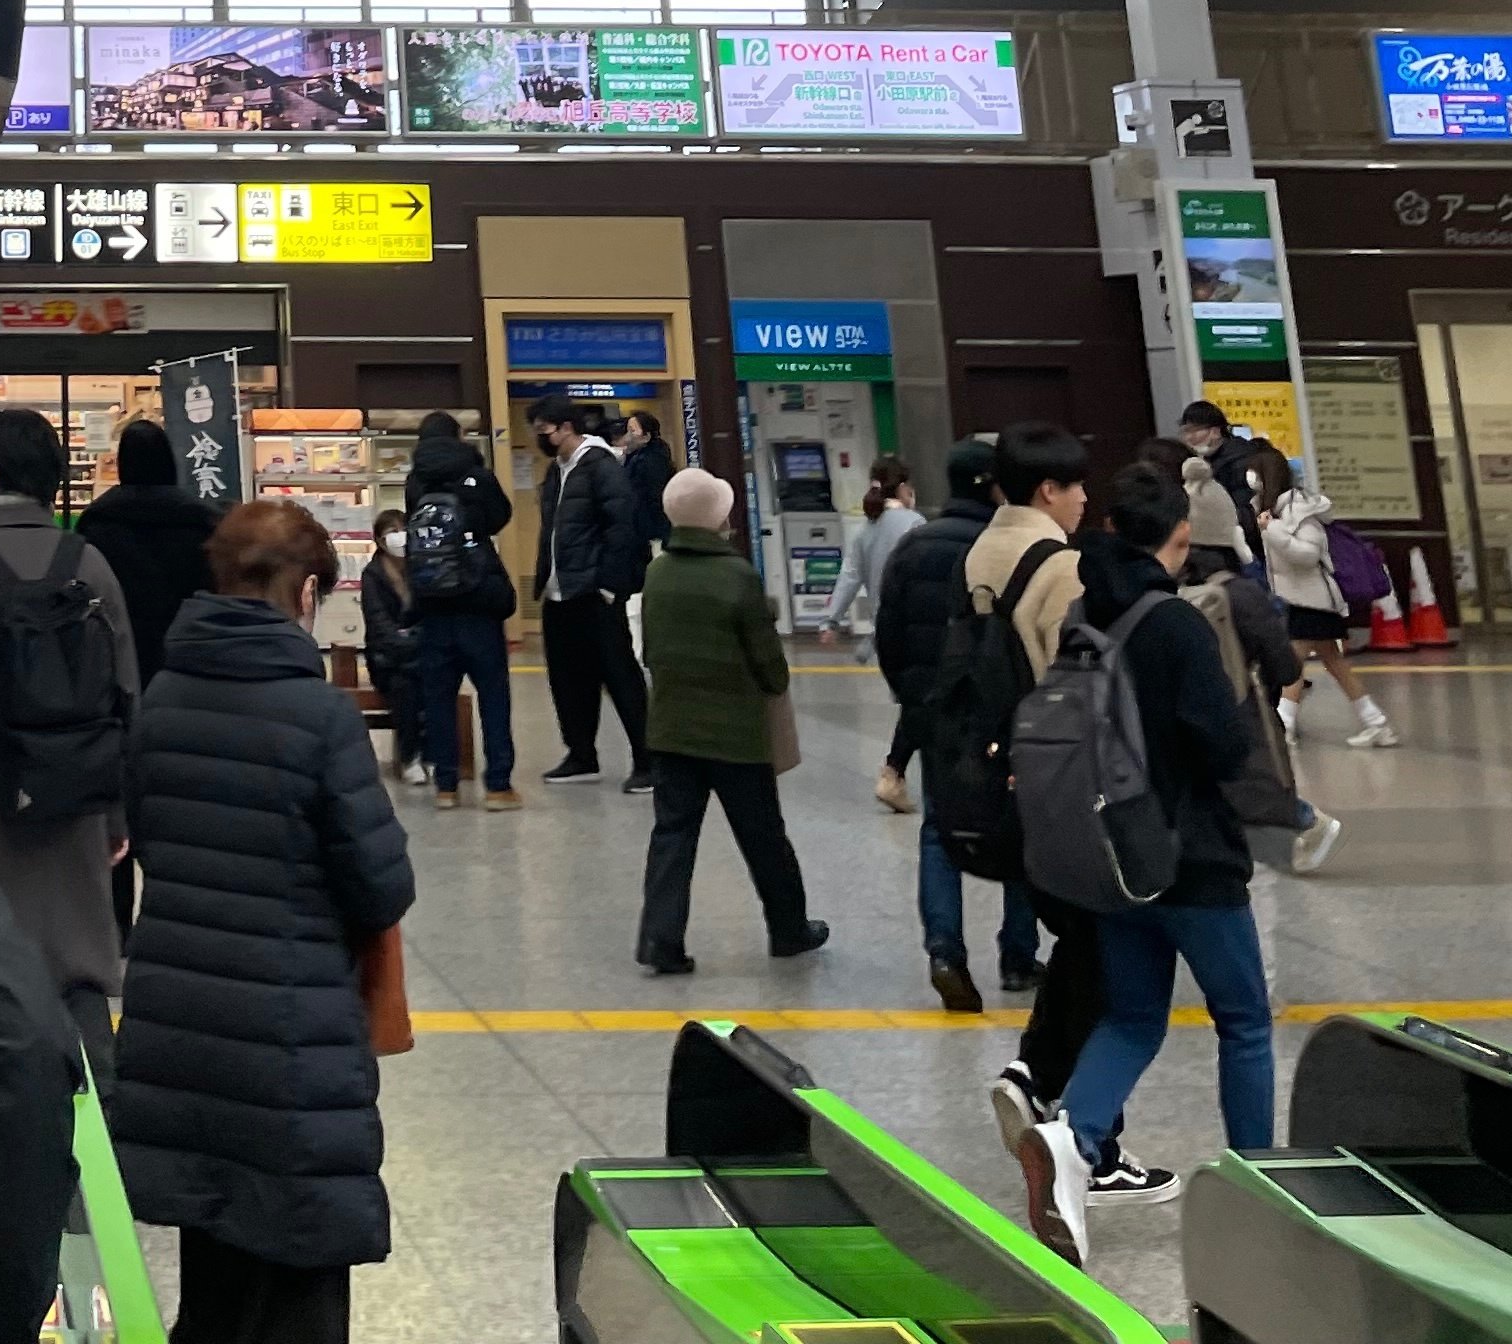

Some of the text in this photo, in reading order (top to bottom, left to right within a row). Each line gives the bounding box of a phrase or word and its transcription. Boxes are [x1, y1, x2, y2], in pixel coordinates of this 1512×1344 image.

[776, 44, 873, 61] TOYOTA
[881, 44, 929, 62] Rent
[935, 49, 946, 62] a
[952, 44, 988, 62] Car
[1409, 53, 1507, 81] 万葉の湯
[909, 71, 935, 81] EAST
[563, 101, 698, 124] 旭丘高等学校
[67, 189, 148, 212] 大雄山線
[247, 191, 272, 200] TAXI
[332, 192, 378, 216] 東口
[72, 213, 144, 227] Daiyuzan Line
[333, 220, 378, 230] East Exit
[282, 235, 342, 247] バスのりば
[282, 248, 325, 259] Bus Stop
[835, 325, 865, 338] ATM
[776, 363, 810, 371] VIEW
